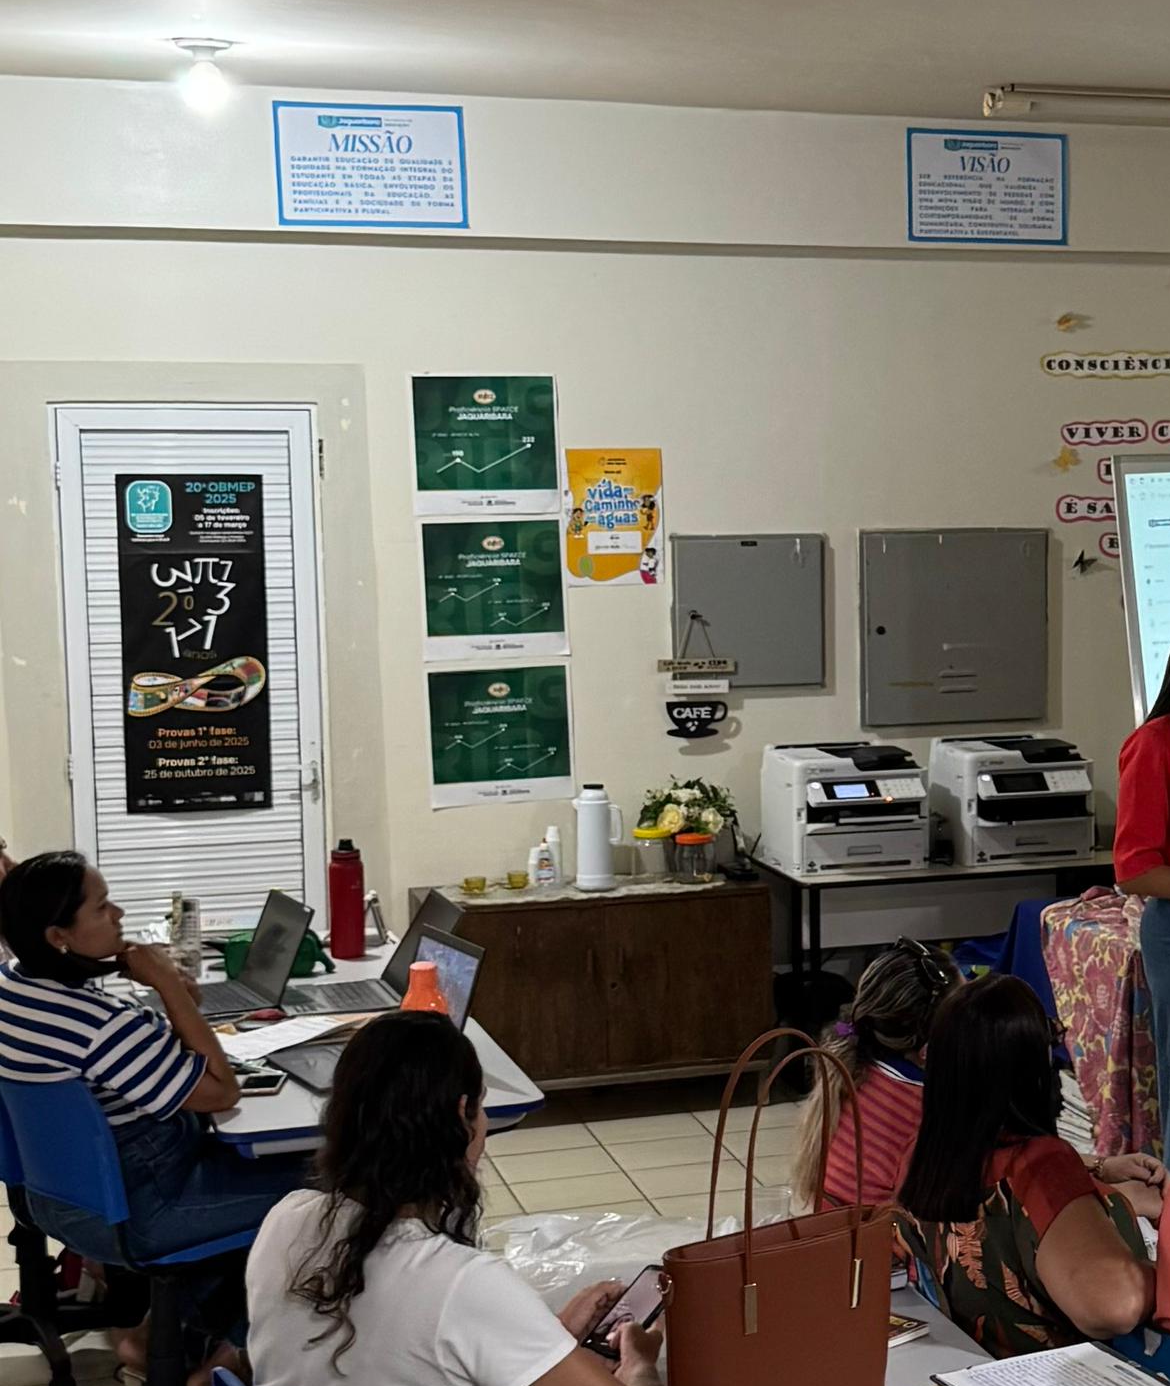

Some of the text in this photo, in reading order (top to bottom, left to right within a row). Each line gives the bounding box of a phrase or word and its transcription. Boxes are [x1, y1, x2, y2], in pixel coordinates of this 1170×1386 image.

[328, 130, 412, 153] MISSÃO
[960, 153, 1010, 173] VISÃO
[1066, 426, 1142, 439] VIVER
[209, 482, 255, 492] OBMEP
[205, 494, 237, 504] 2025
[585, 499, 640, 512] Caminho
[1063, 498, 1078, 514] É
[598, 513, 638, 529] águas
[158, 728, 196, 737] Provas
[209, 726, 236, 735] fase:
[149, 737, 249, 750] 03 de junho de 2025
[158, 757, 196, 767] Provas
[211, 756, 239, 765] fase:
[143, 765, 255, 779] 25 de outubro de 2025
